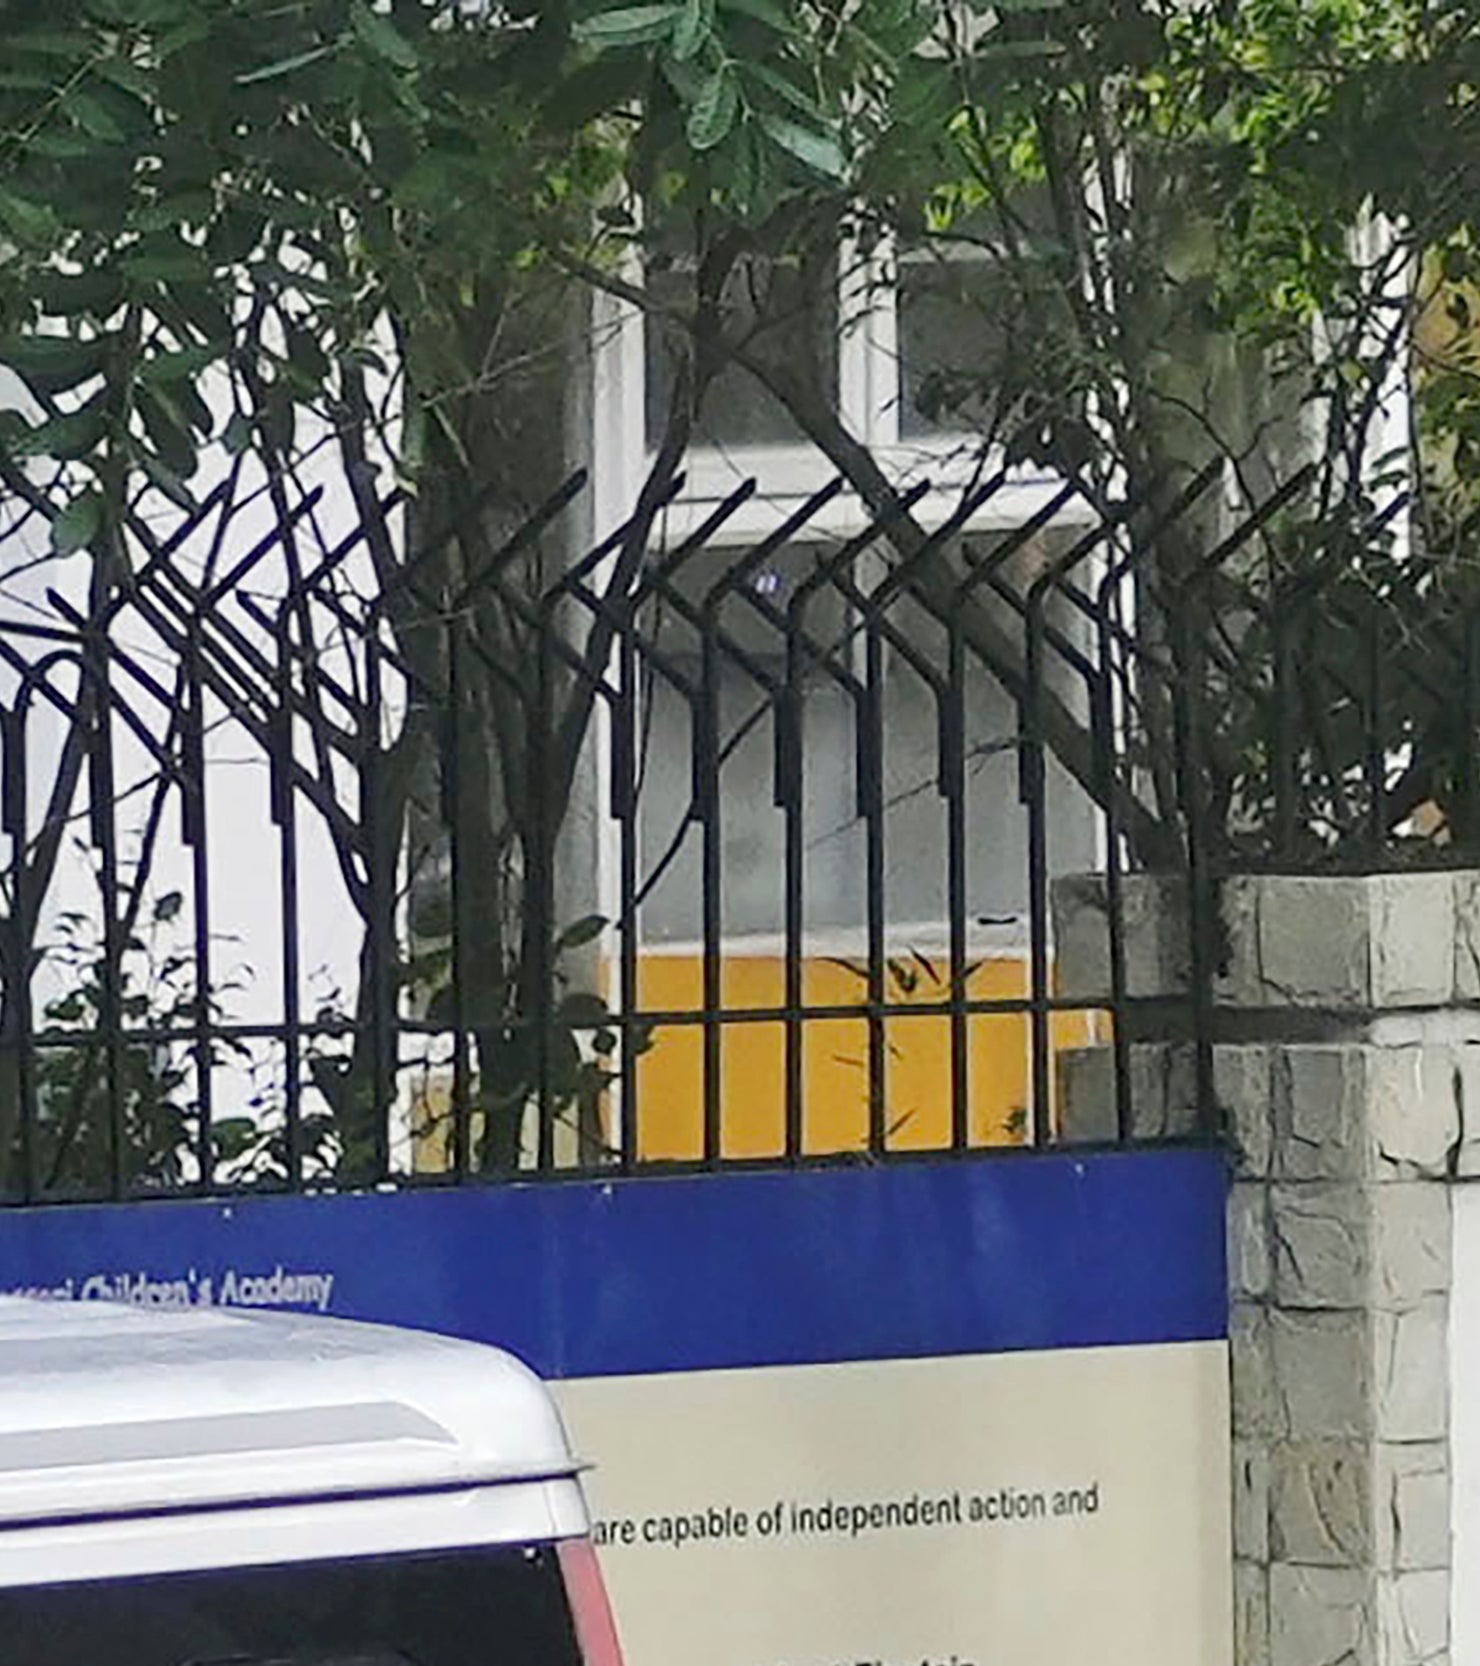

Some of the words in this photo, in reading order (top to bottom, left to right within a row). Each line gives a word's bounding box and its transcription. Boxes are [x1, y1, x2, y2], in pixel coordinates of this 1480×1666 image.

[221, 1266, 334, 1311] Academy
[642, 1504, 749, 1550] capable
[755, 1504, 783, 1536] of
[789, 1491, 963, 1538] independent
[969, 1488, 1047, 1524] action
[1052, 1482, 1099, 1516] and
